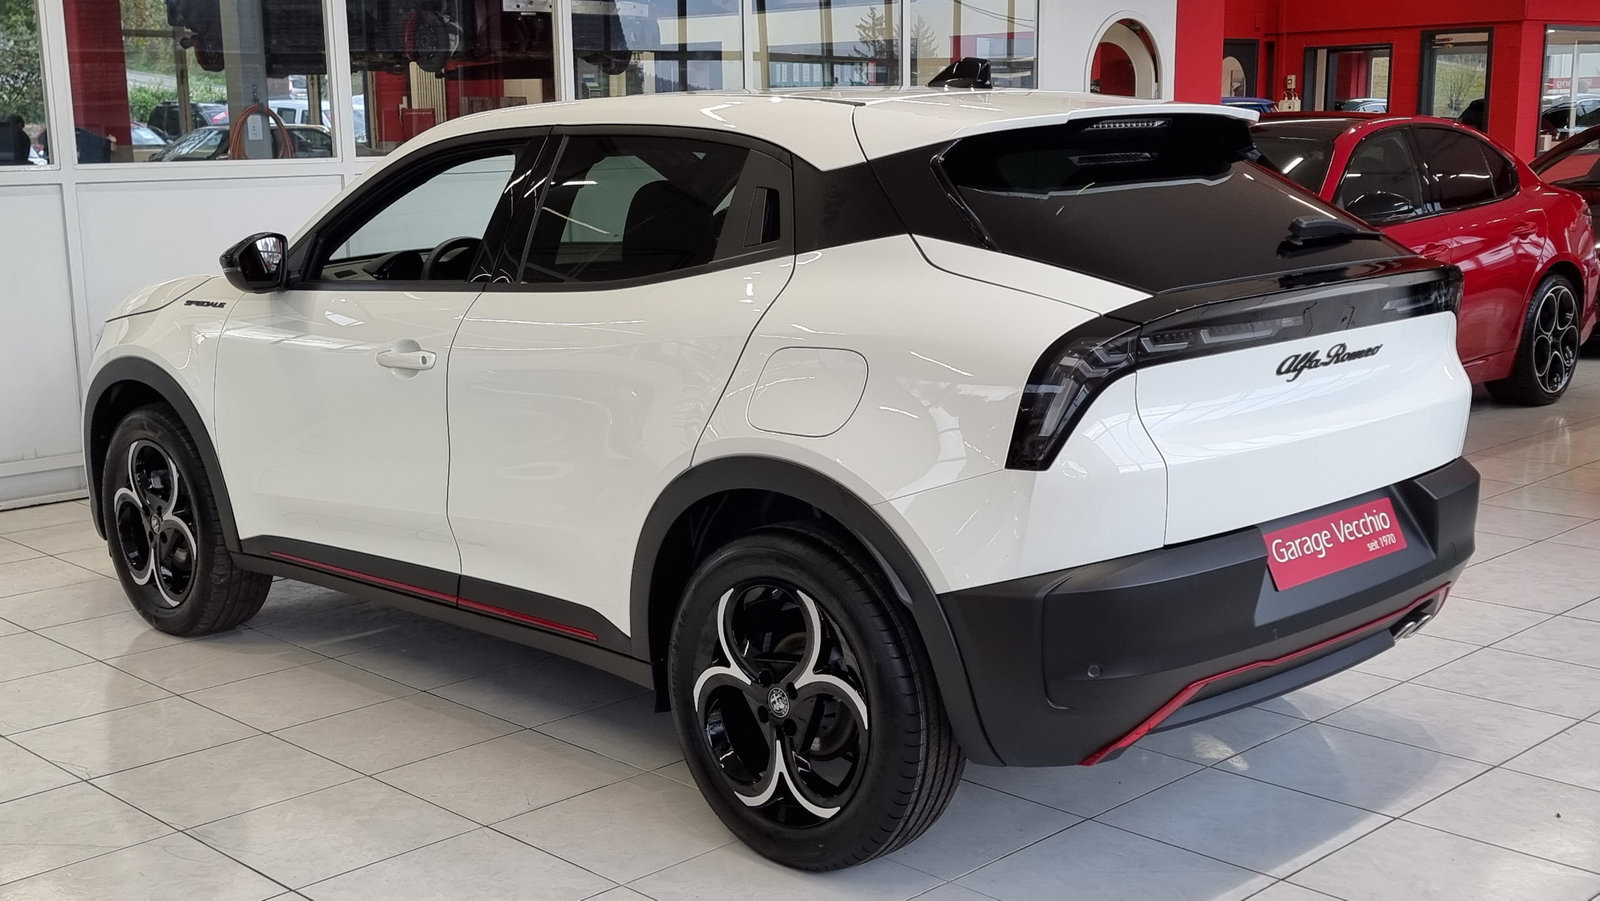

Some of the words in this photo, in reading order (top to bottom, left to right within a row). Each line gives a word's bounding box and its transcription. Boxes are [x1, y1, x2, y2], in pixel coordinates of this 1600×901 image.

[184, 300, 227, 308] SPECIALE
[1276, 350, 1321, 382] Alfa
[1321, 343, 1384, 366] Romeo
[1271, 529, 1334, 563] Garage
[1330, 509, 1391, 543] Vecchio
[1366, 539, 1380, 552] seit
[1379, 533, 1397, 548] 1970
